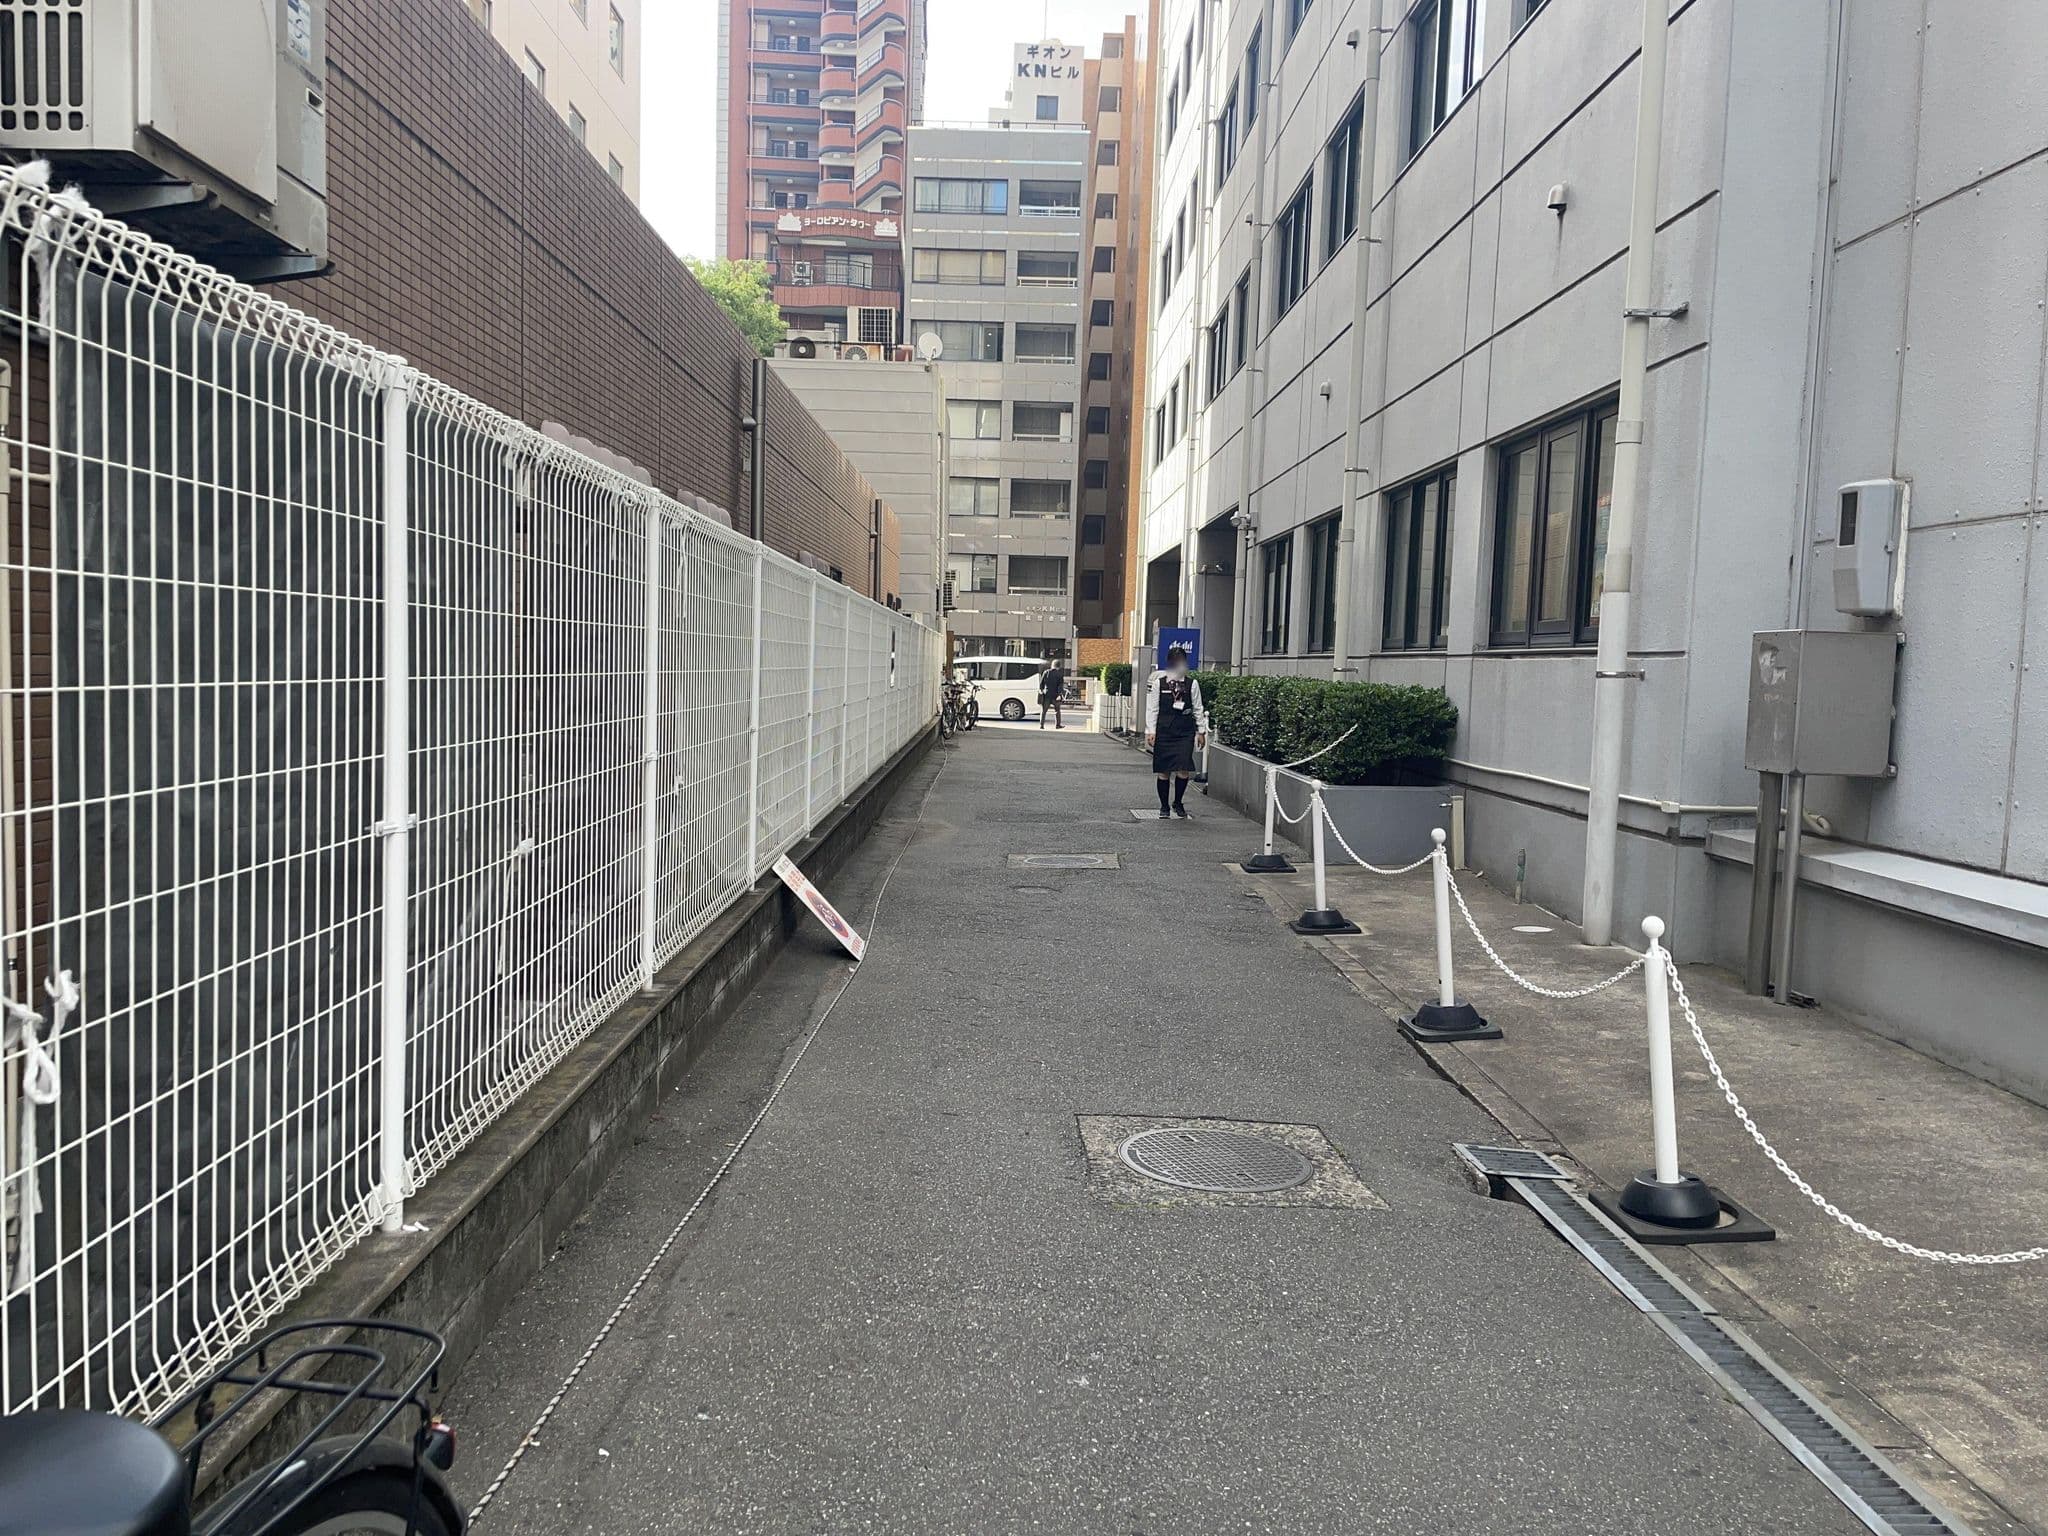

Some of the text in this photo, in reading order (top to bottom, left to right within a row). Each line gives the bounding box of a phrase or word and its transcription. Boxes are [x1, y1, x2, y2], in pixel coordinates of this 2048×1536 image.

[1027, 45, 1071, 59] ギオン
[1017, 63, 1080, 79] KNビル
[804, 216, 871, 229] ヨーロピアン・タワー
